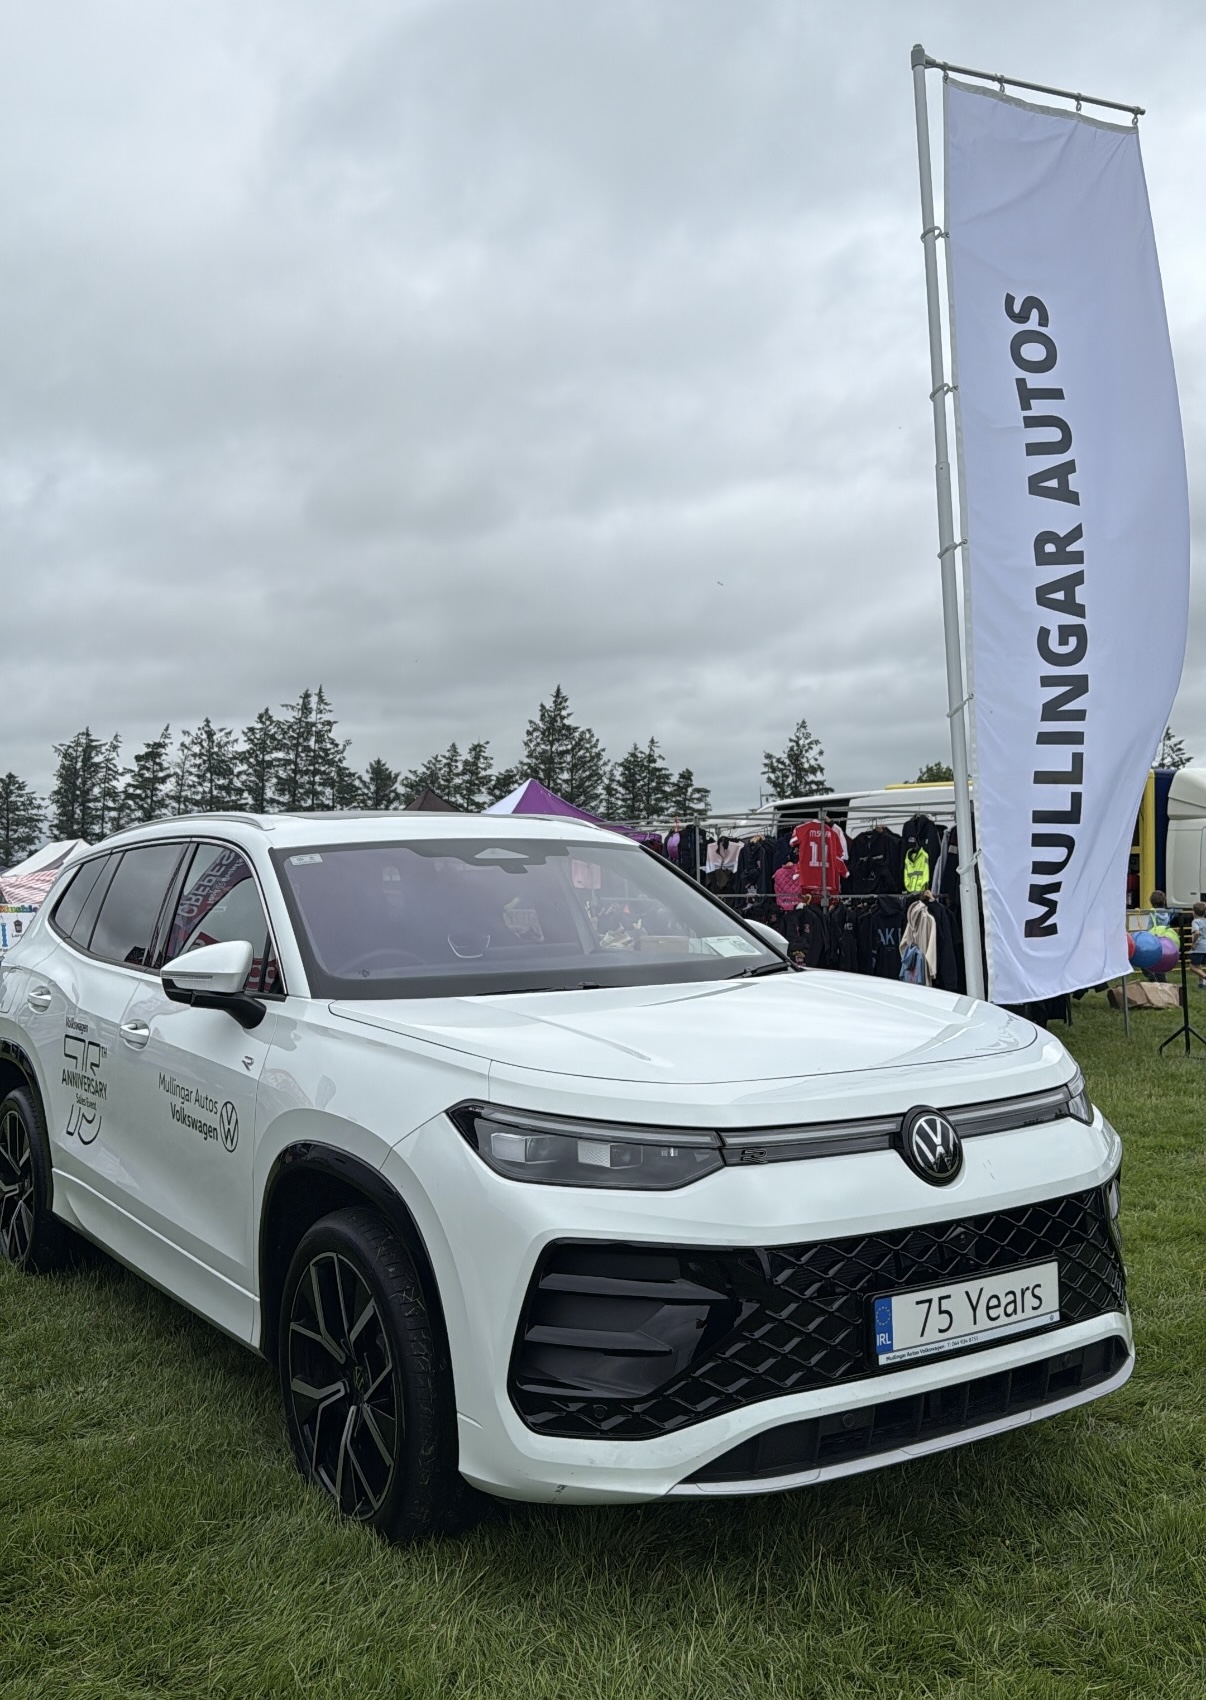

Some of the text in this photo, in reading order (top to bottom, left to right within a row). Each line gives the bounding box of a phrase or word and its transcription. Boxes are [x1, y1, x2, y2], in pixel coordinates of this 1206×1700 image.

[1004, 292, 1090, 939] MULLINGAR AUTOS
[62, 1068, 108, 1100] ANNIVERSARY
[159, 1072, 218, 1115] Mullingar Autos
[170, 1101, 218, 1141] Volkswagen
[915, 1283, 1043, 1338] 75 Years
[876, 1333, 891, 1346] IRL
